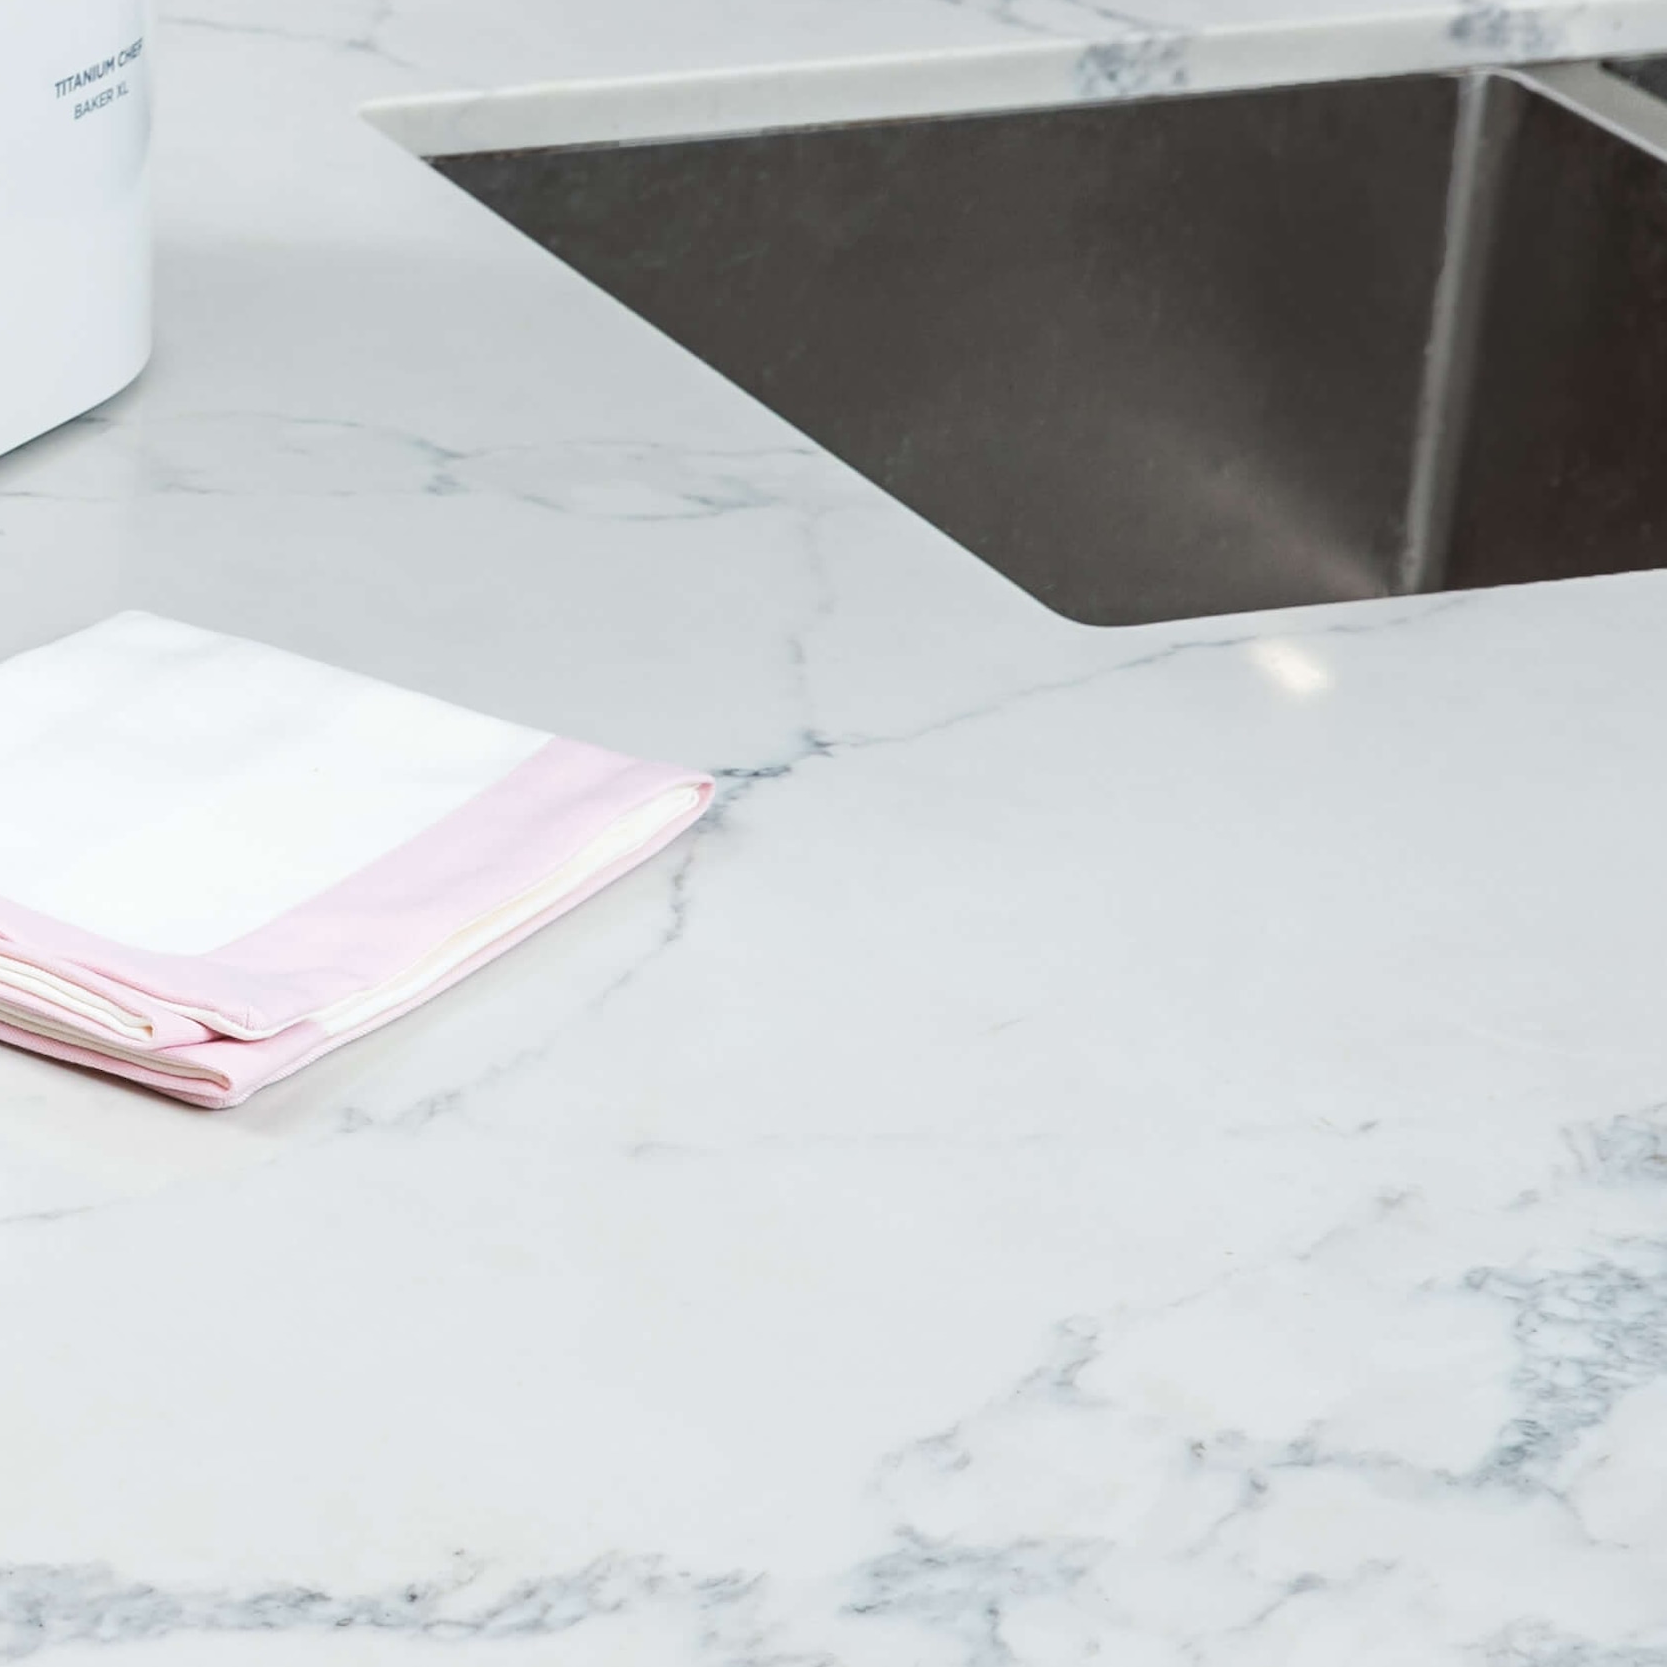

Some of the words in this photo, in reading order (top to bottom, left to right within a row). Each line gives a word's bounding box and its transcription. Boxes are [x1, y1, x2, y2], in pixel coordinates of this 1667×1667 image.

[54, 56, 115, 99] TITANIUM
[74, 87, 114, 120] BAKER
[116, 81, 129, 99] XL
